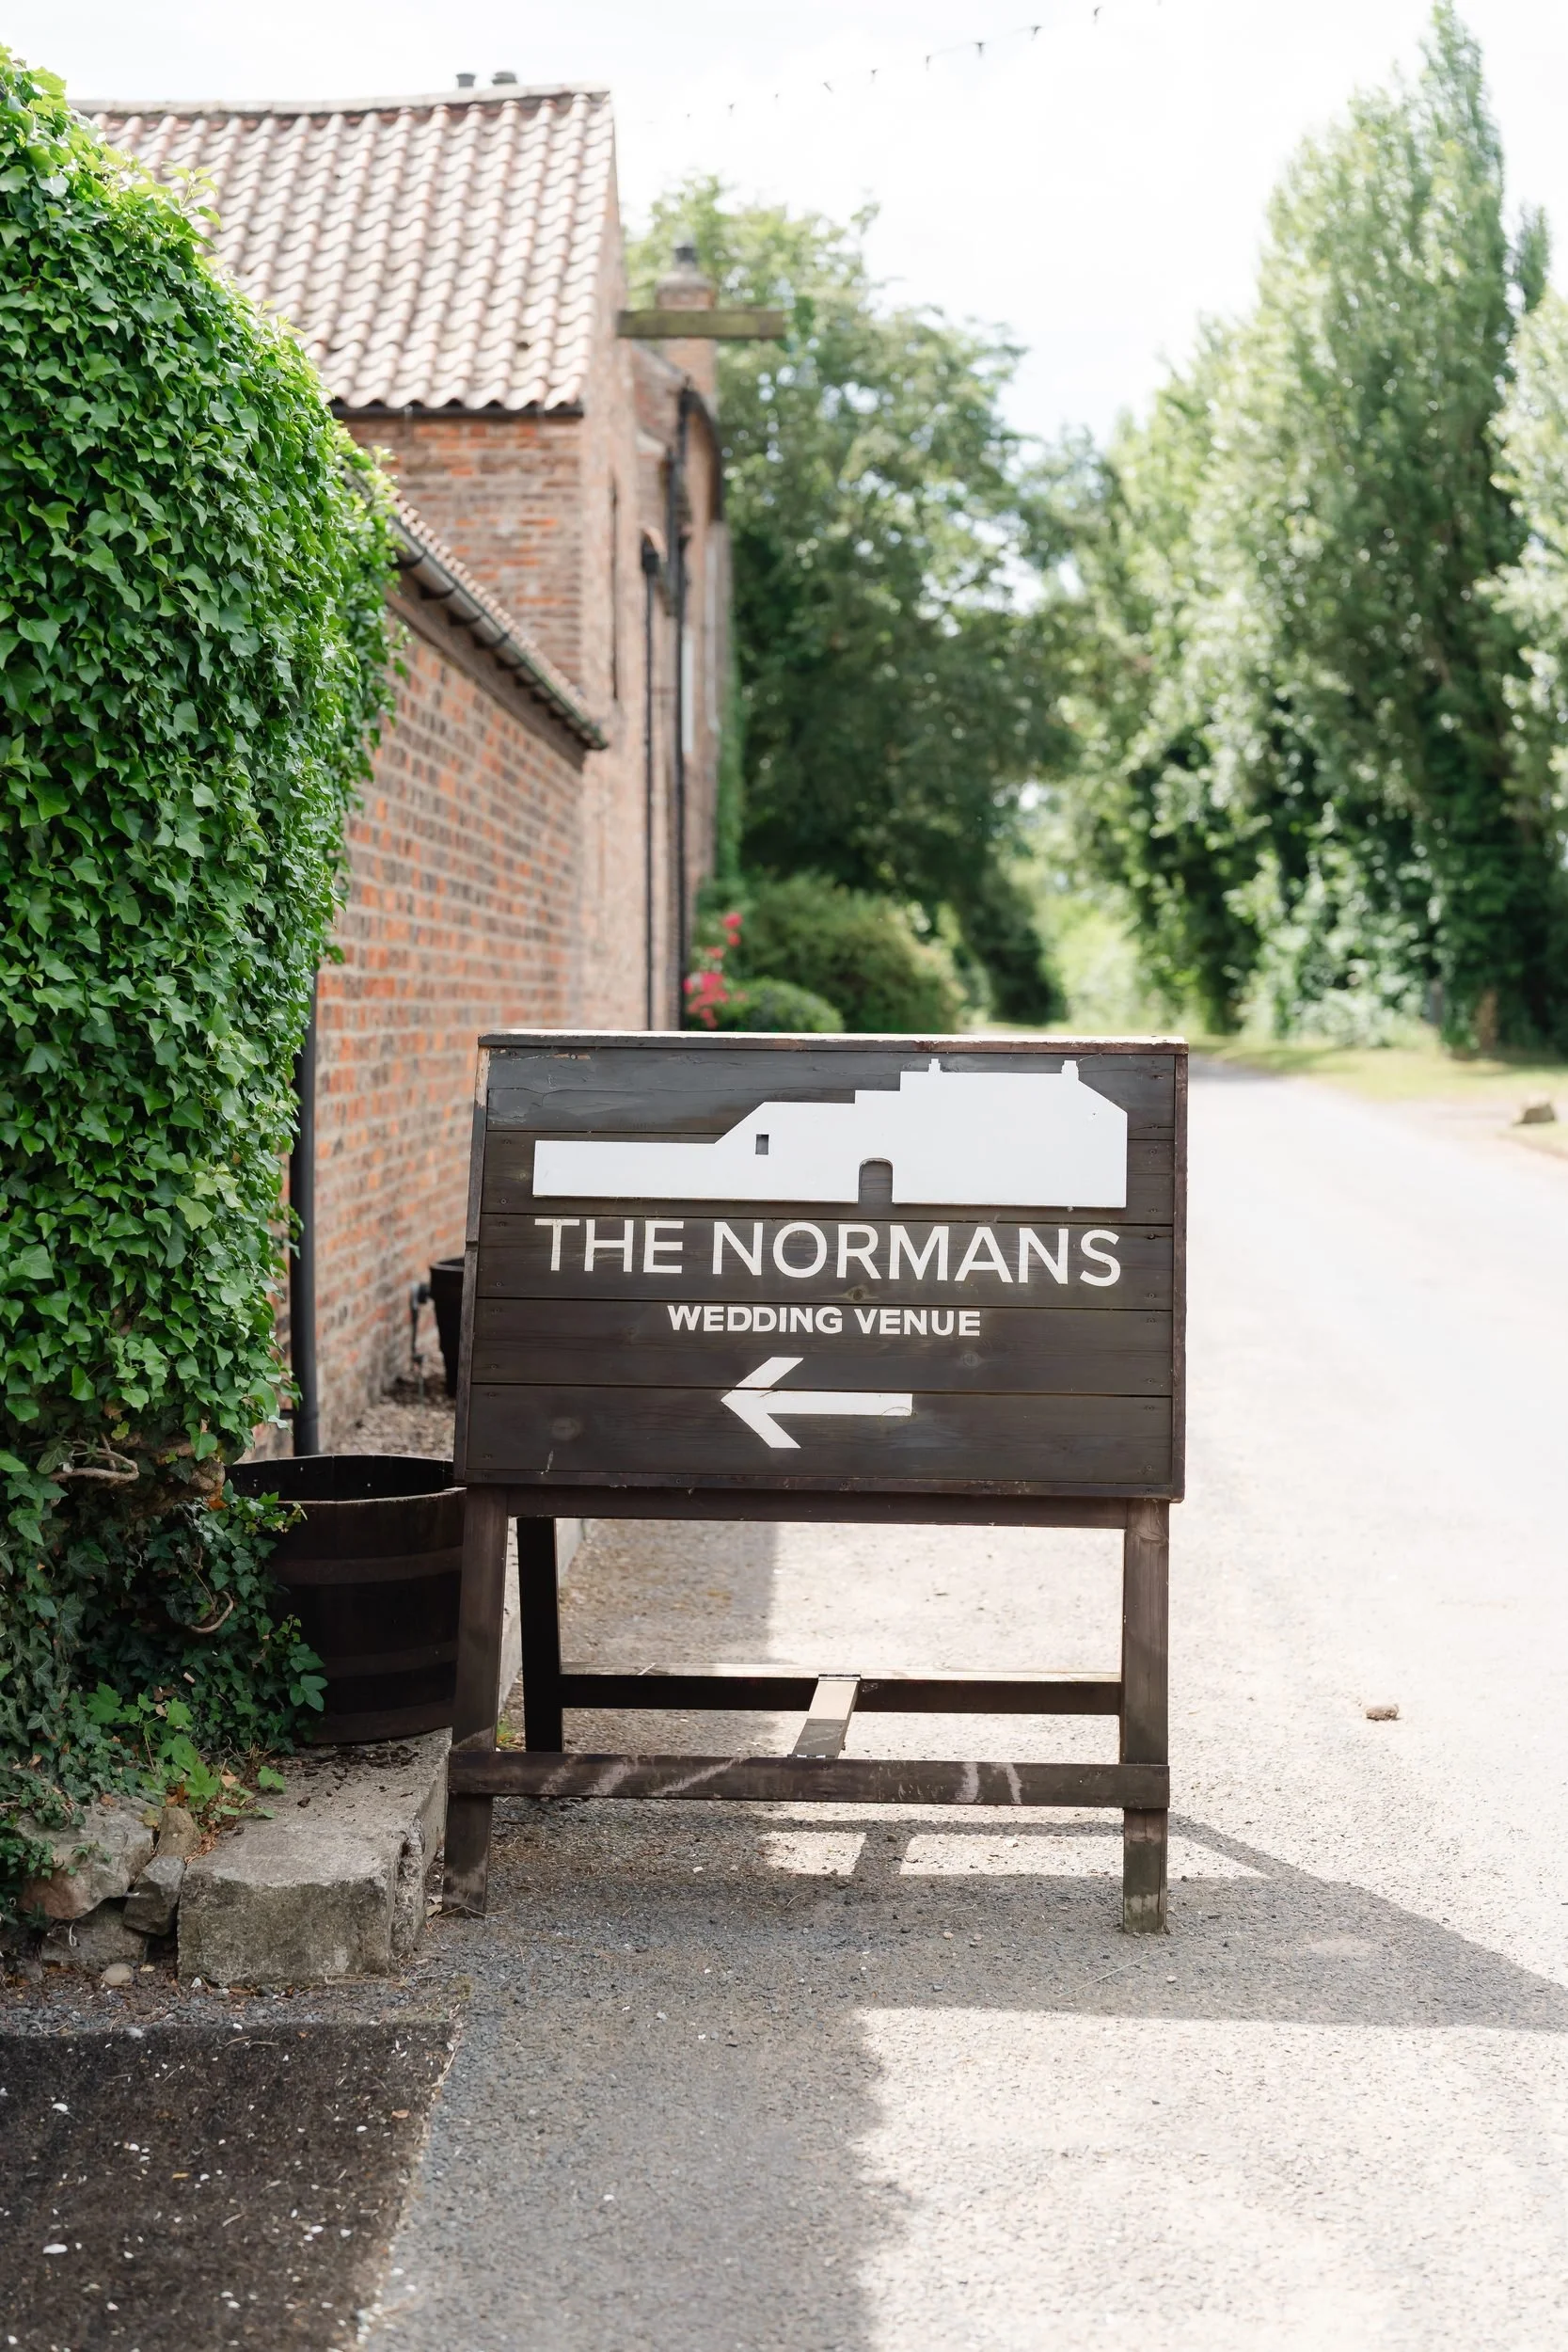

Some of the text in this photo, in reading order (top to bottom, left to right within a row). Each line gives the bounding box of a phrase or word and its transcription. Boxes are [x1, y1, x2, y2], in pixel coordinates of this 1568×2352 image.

[534, 1217, 1121, 1287] THE NORMANS
[667, 1305, 981, 1336] WEDDING VENUE
